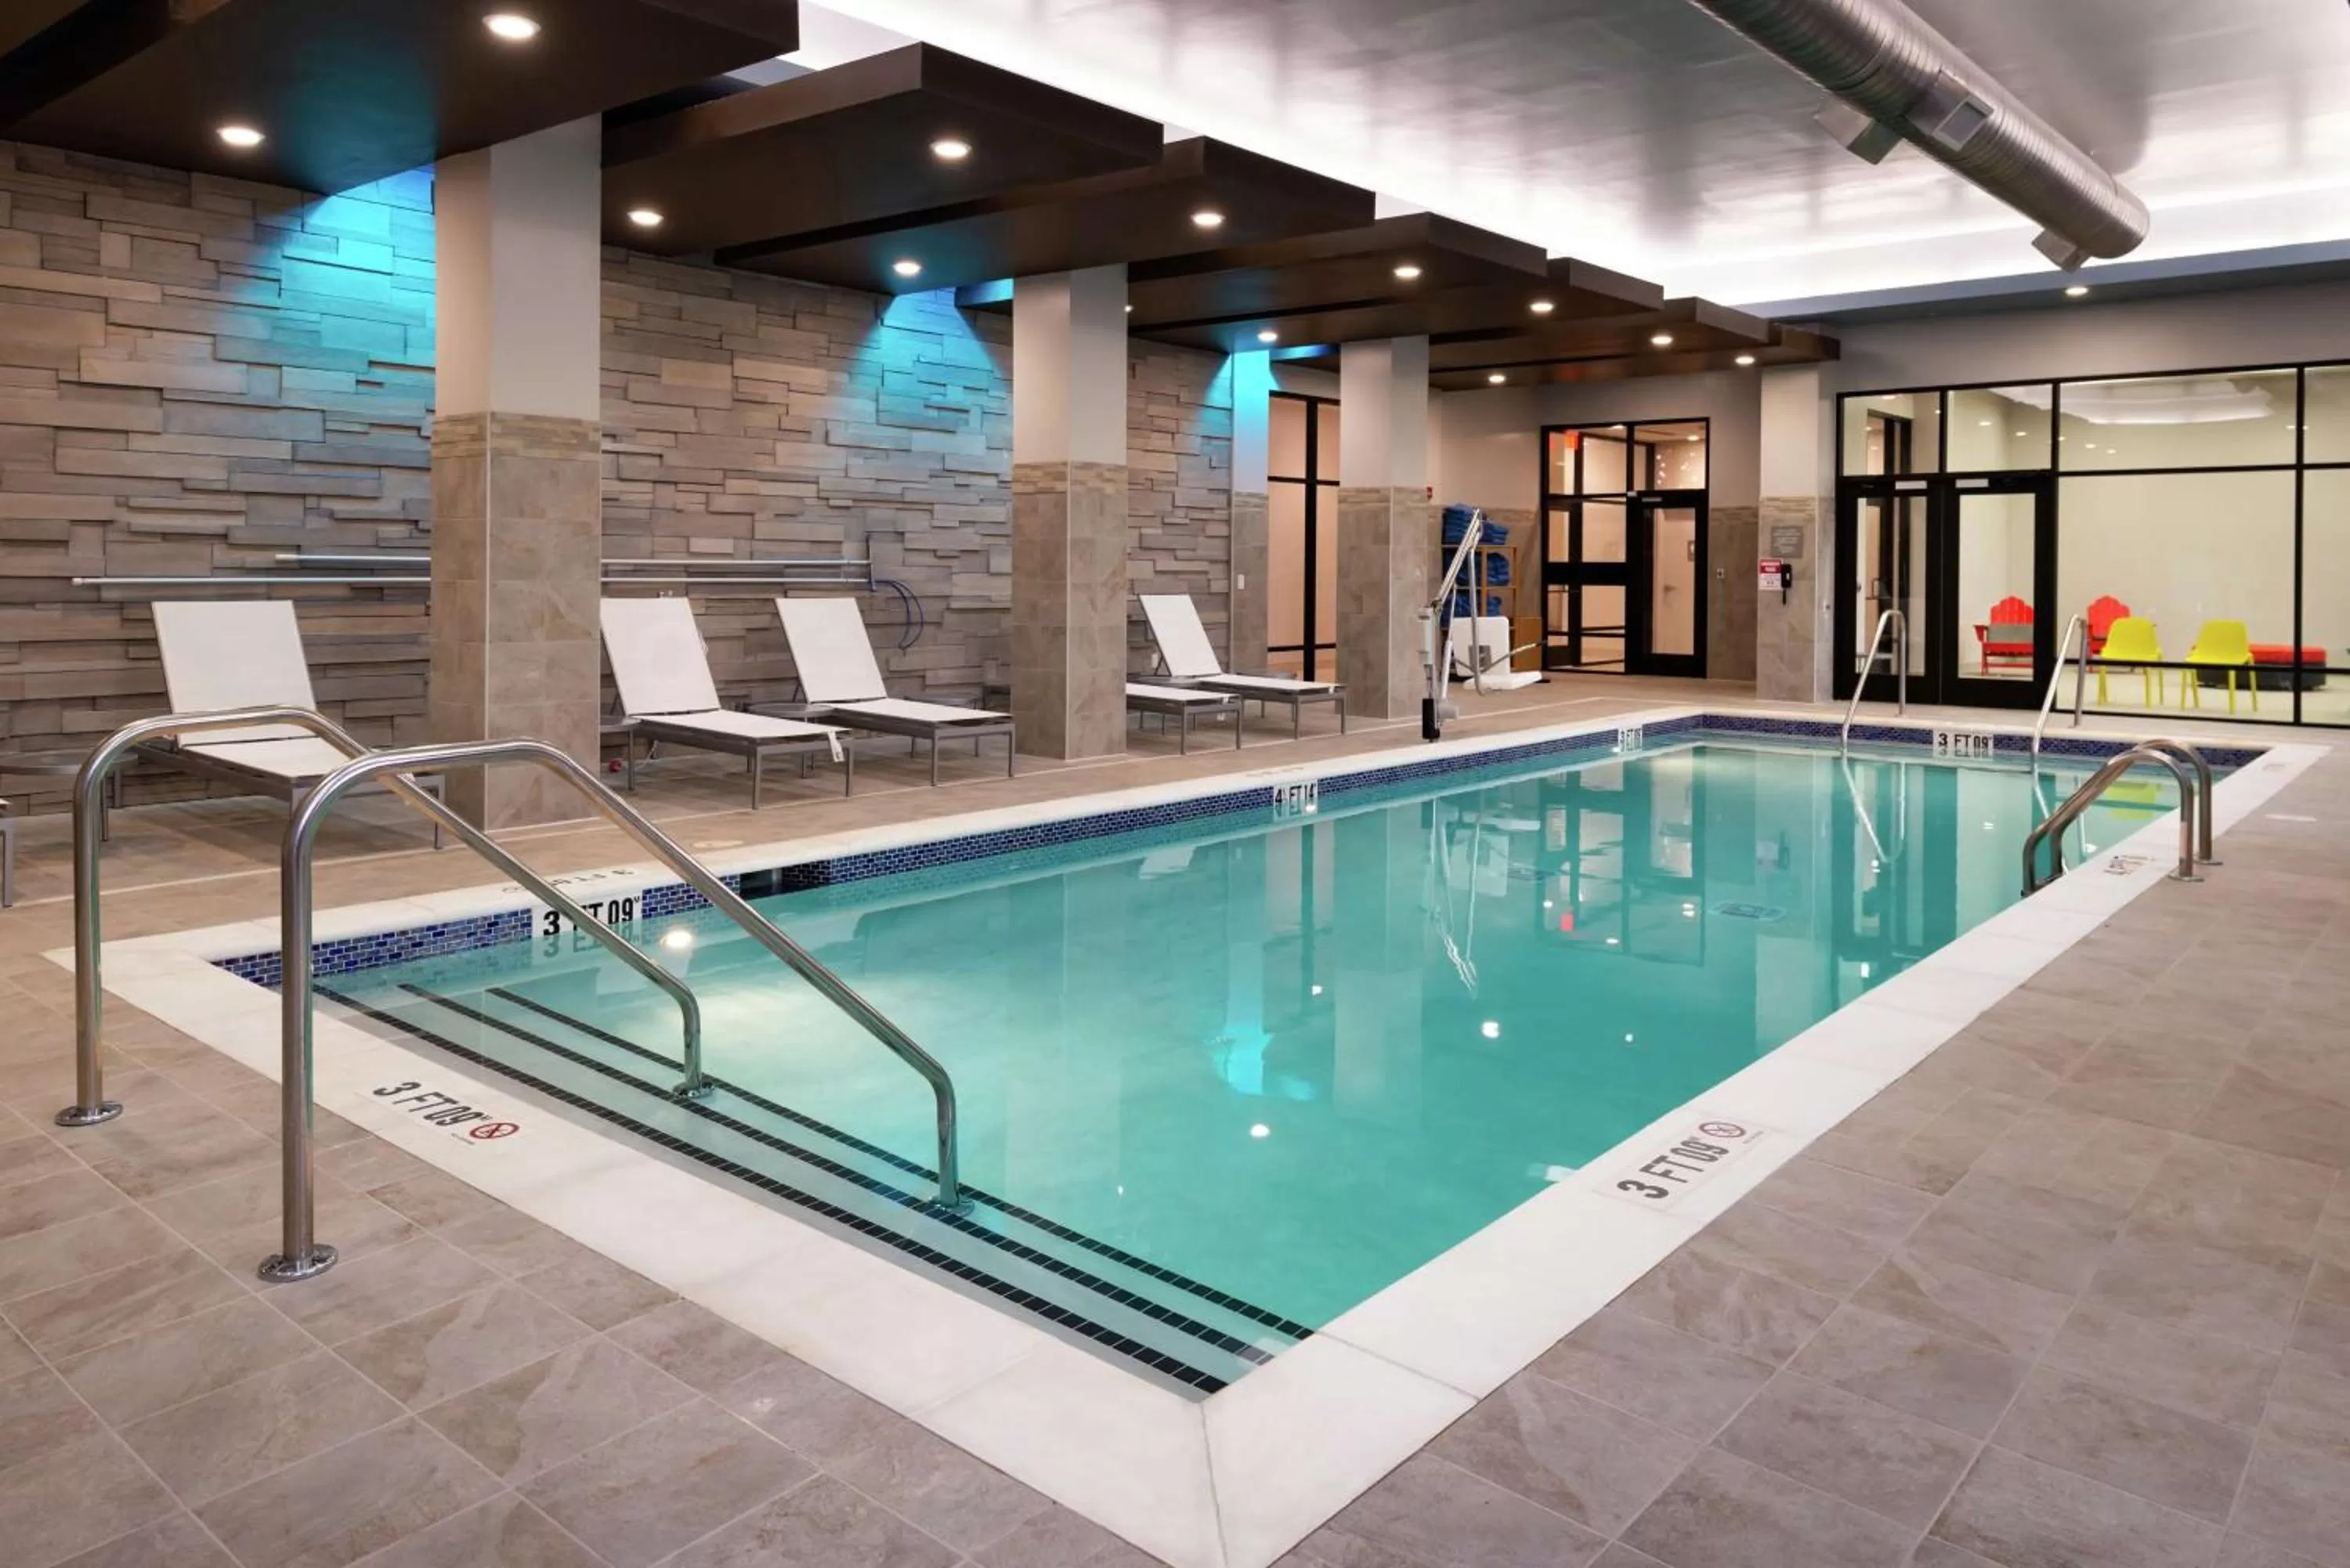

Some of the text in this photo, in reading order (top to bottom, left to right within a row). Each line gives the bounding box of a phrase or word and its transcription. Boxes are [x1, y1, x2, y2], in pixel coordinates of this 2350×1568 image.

[1939, 733, 1947, 746] 3
[1954, 734, 1971, 749] FT
[543, 911, 560, 936] 3
[372, 1082, 422, 1097] 3
[1616, 1180, 1669, 1199] 3
